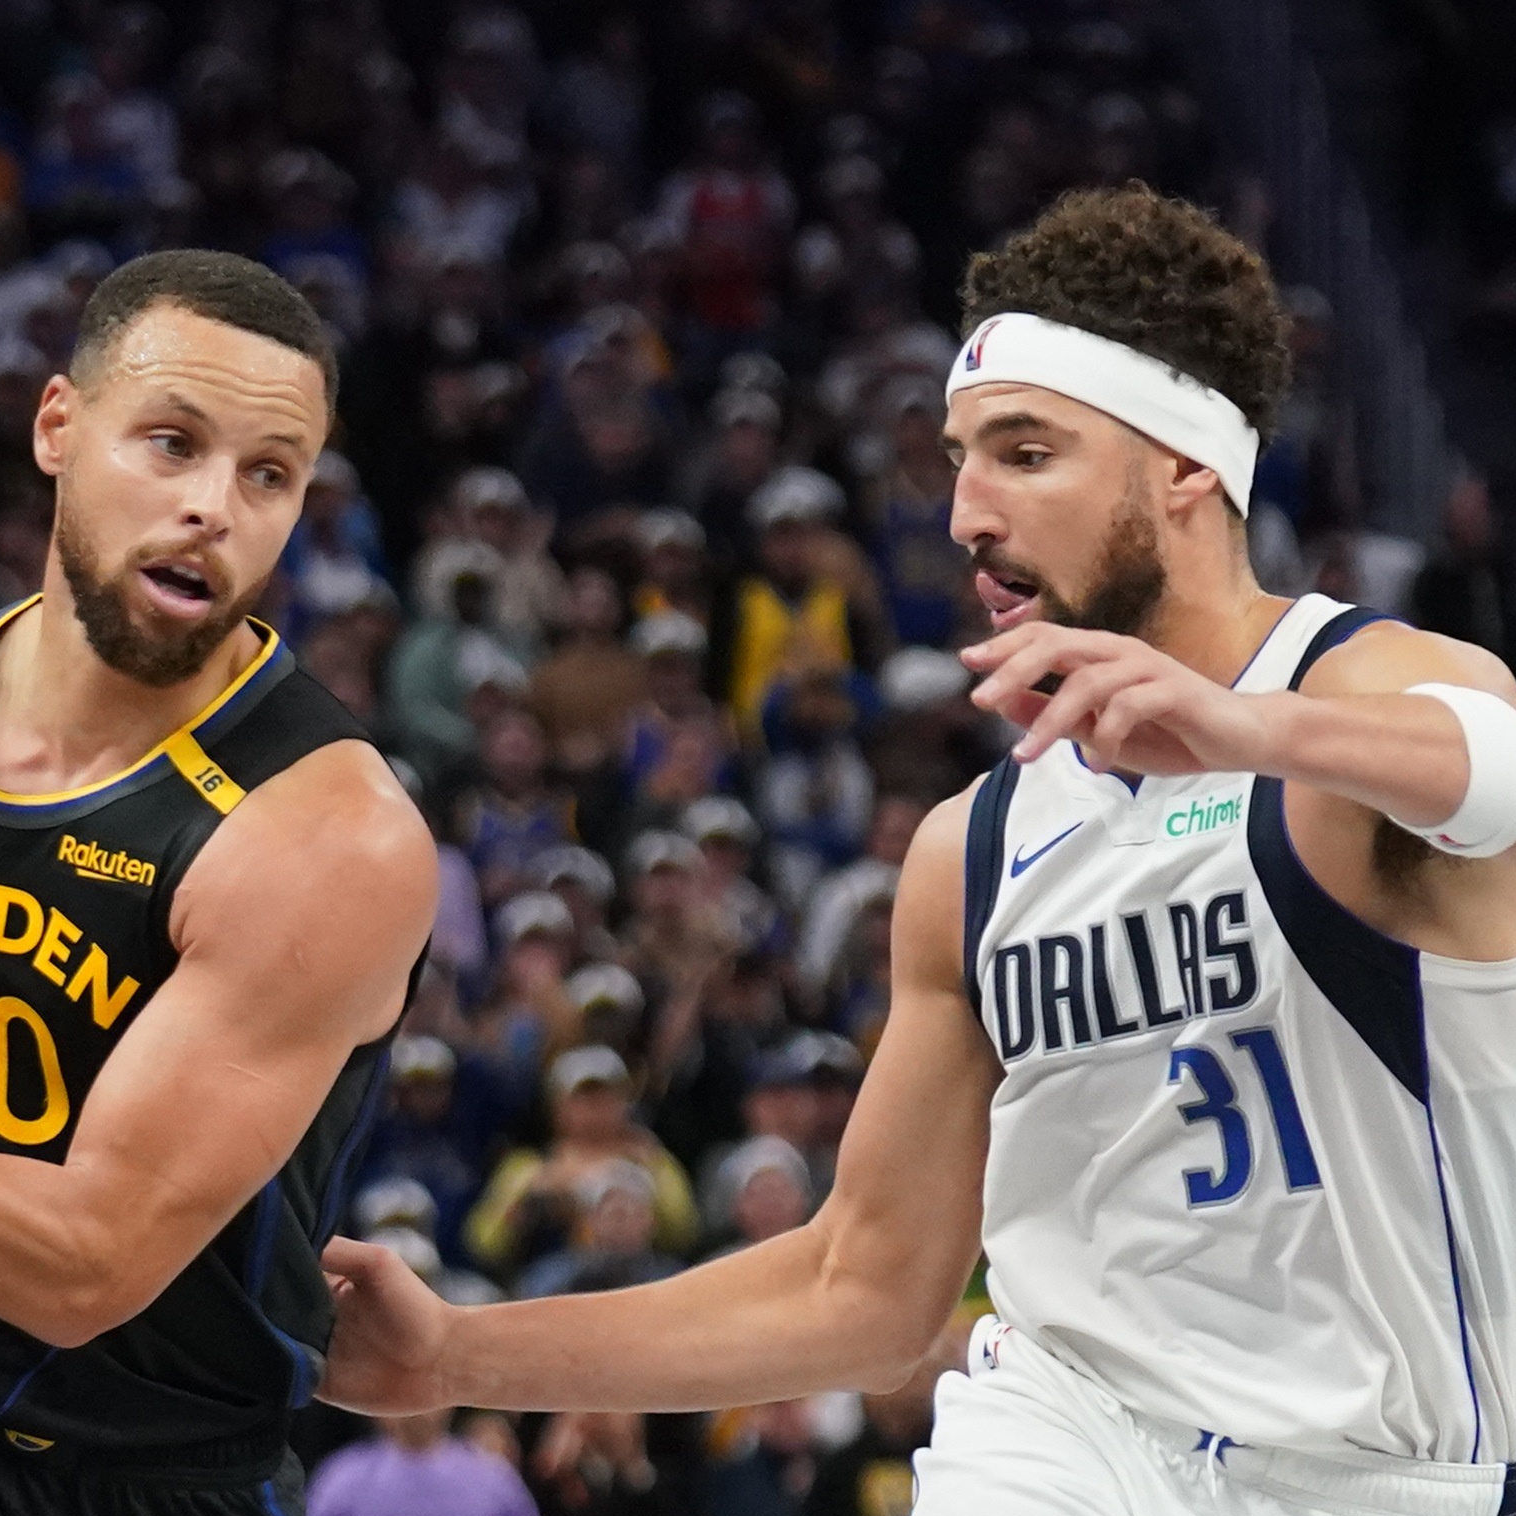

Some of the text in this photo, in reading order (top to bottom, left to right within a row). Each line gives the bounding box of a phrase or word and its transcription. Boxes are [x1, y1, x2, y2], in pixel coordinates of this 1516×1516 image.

[195, 766, 225, 794] 16
[57, 833, 157, 887] Rakuten
[992, 888, 1262, 1065] DALLAS
[1166, 1024, 1327, 1211] 31
